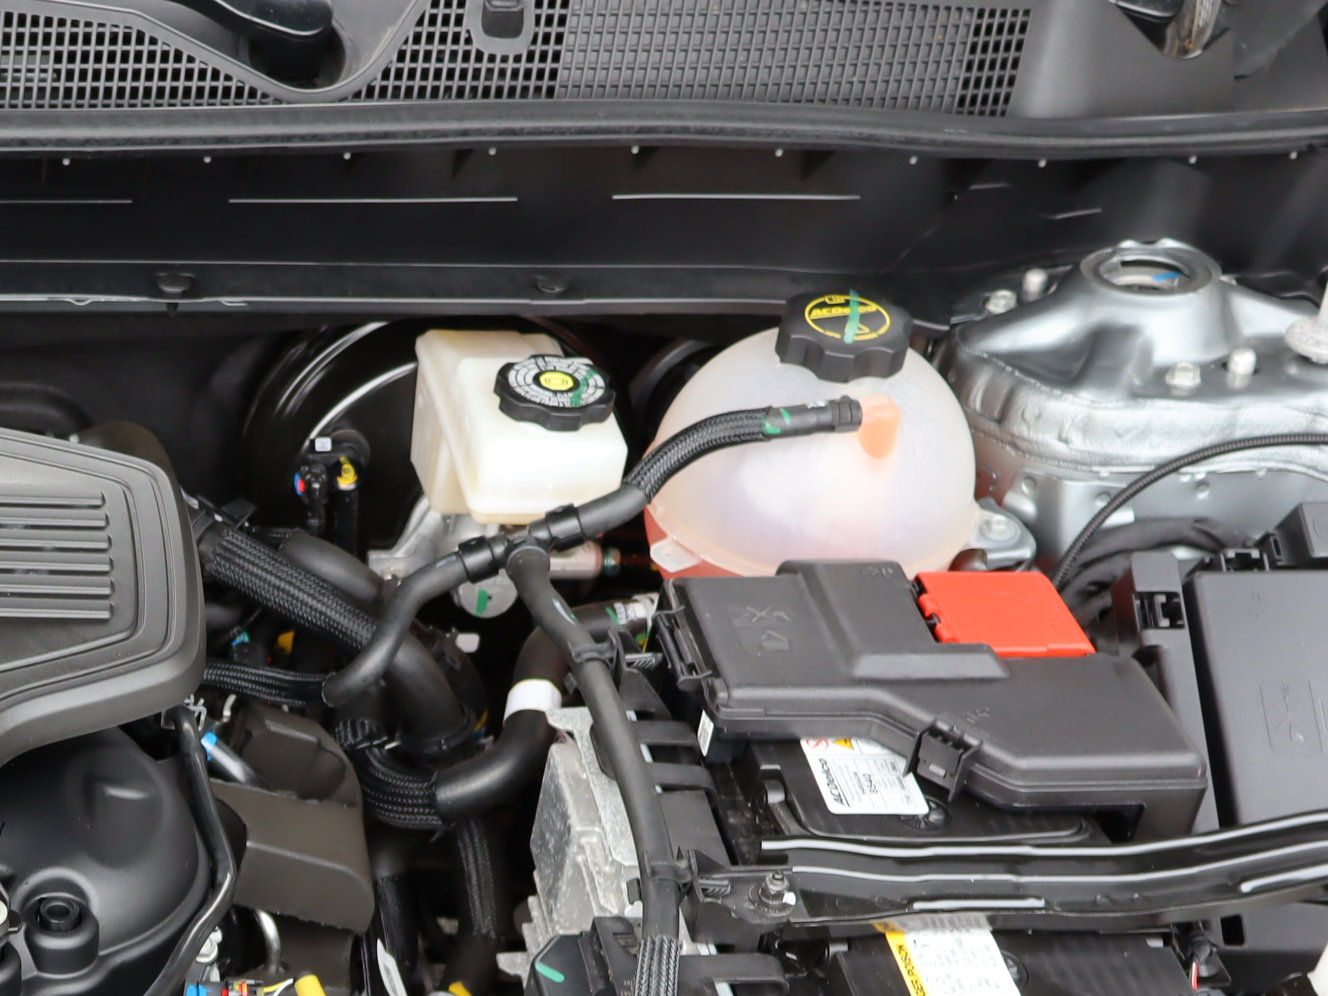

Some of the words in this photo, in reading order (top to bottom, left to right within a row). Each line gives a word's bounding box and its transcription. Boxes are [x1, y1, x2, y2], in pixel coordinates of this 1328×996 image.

[810, 305, 877, 319] ACDeco
[818, 758, 846, 806] ACDelco
[897, 944, 915, 977] POISON
